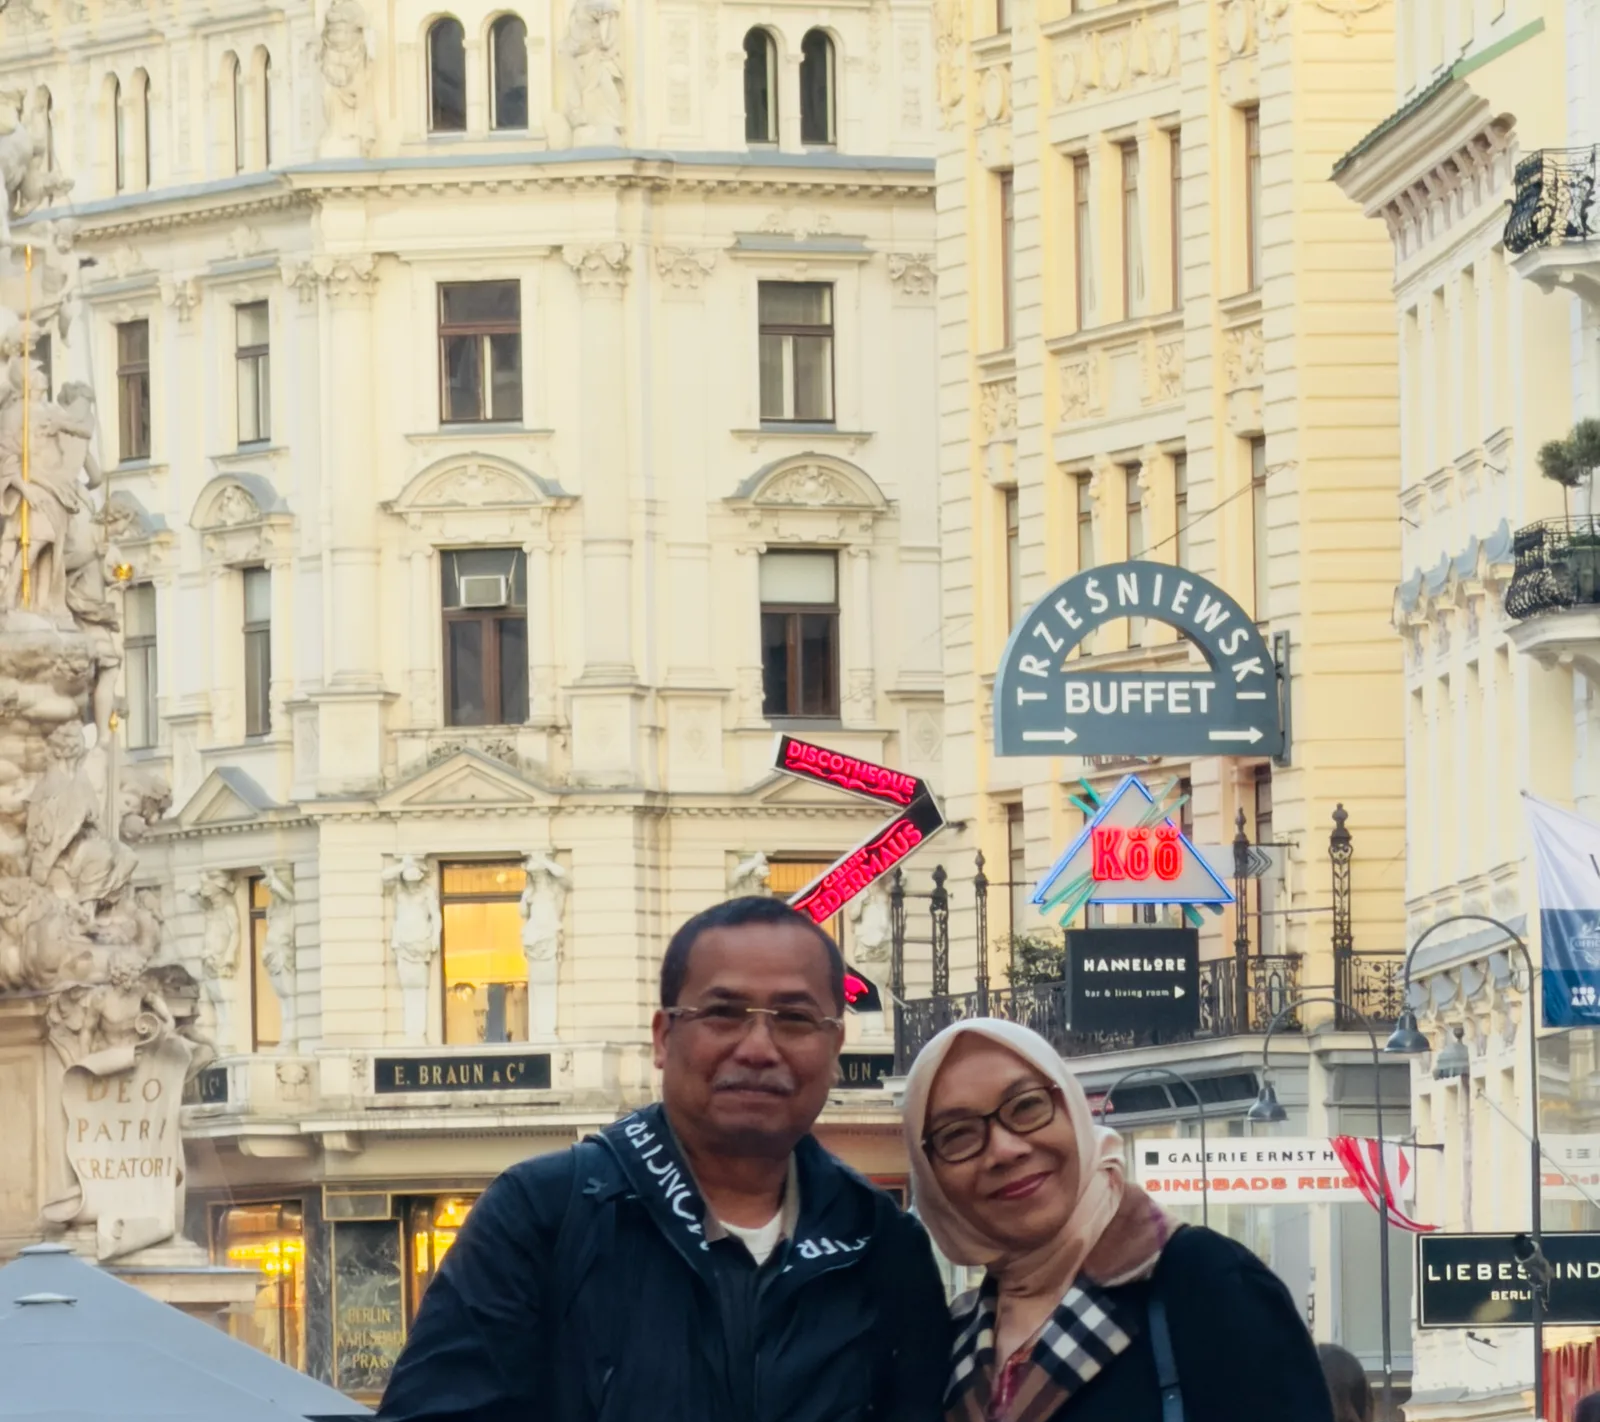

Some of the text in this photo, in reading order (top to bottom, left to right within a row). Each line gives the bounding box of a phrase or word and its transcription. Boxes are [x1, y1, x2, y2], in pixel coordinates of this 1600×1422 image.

[1065, 681, 1216, 714] BUFFET
[786, 740, 916, 796] DISCOTHEQUE
[807, 823, 923, 925] EDERMAUS
[419, 1064, 484, 1085] BRAUN
[86, 1077, 162, 1104] DEO
[77, 1117, 167, 1143] PATRI
[76, 1156, 172, 1180] CREATORI
[1168, 1150, 1335, 1164] GALERIE ERNST H
[1145, 1176, 1358, 1192] SINDBADS REIS
[1428, 1261, 1600, 1282] LIEBESIND
[1491, 1290, 1532, 1301] BERLI
